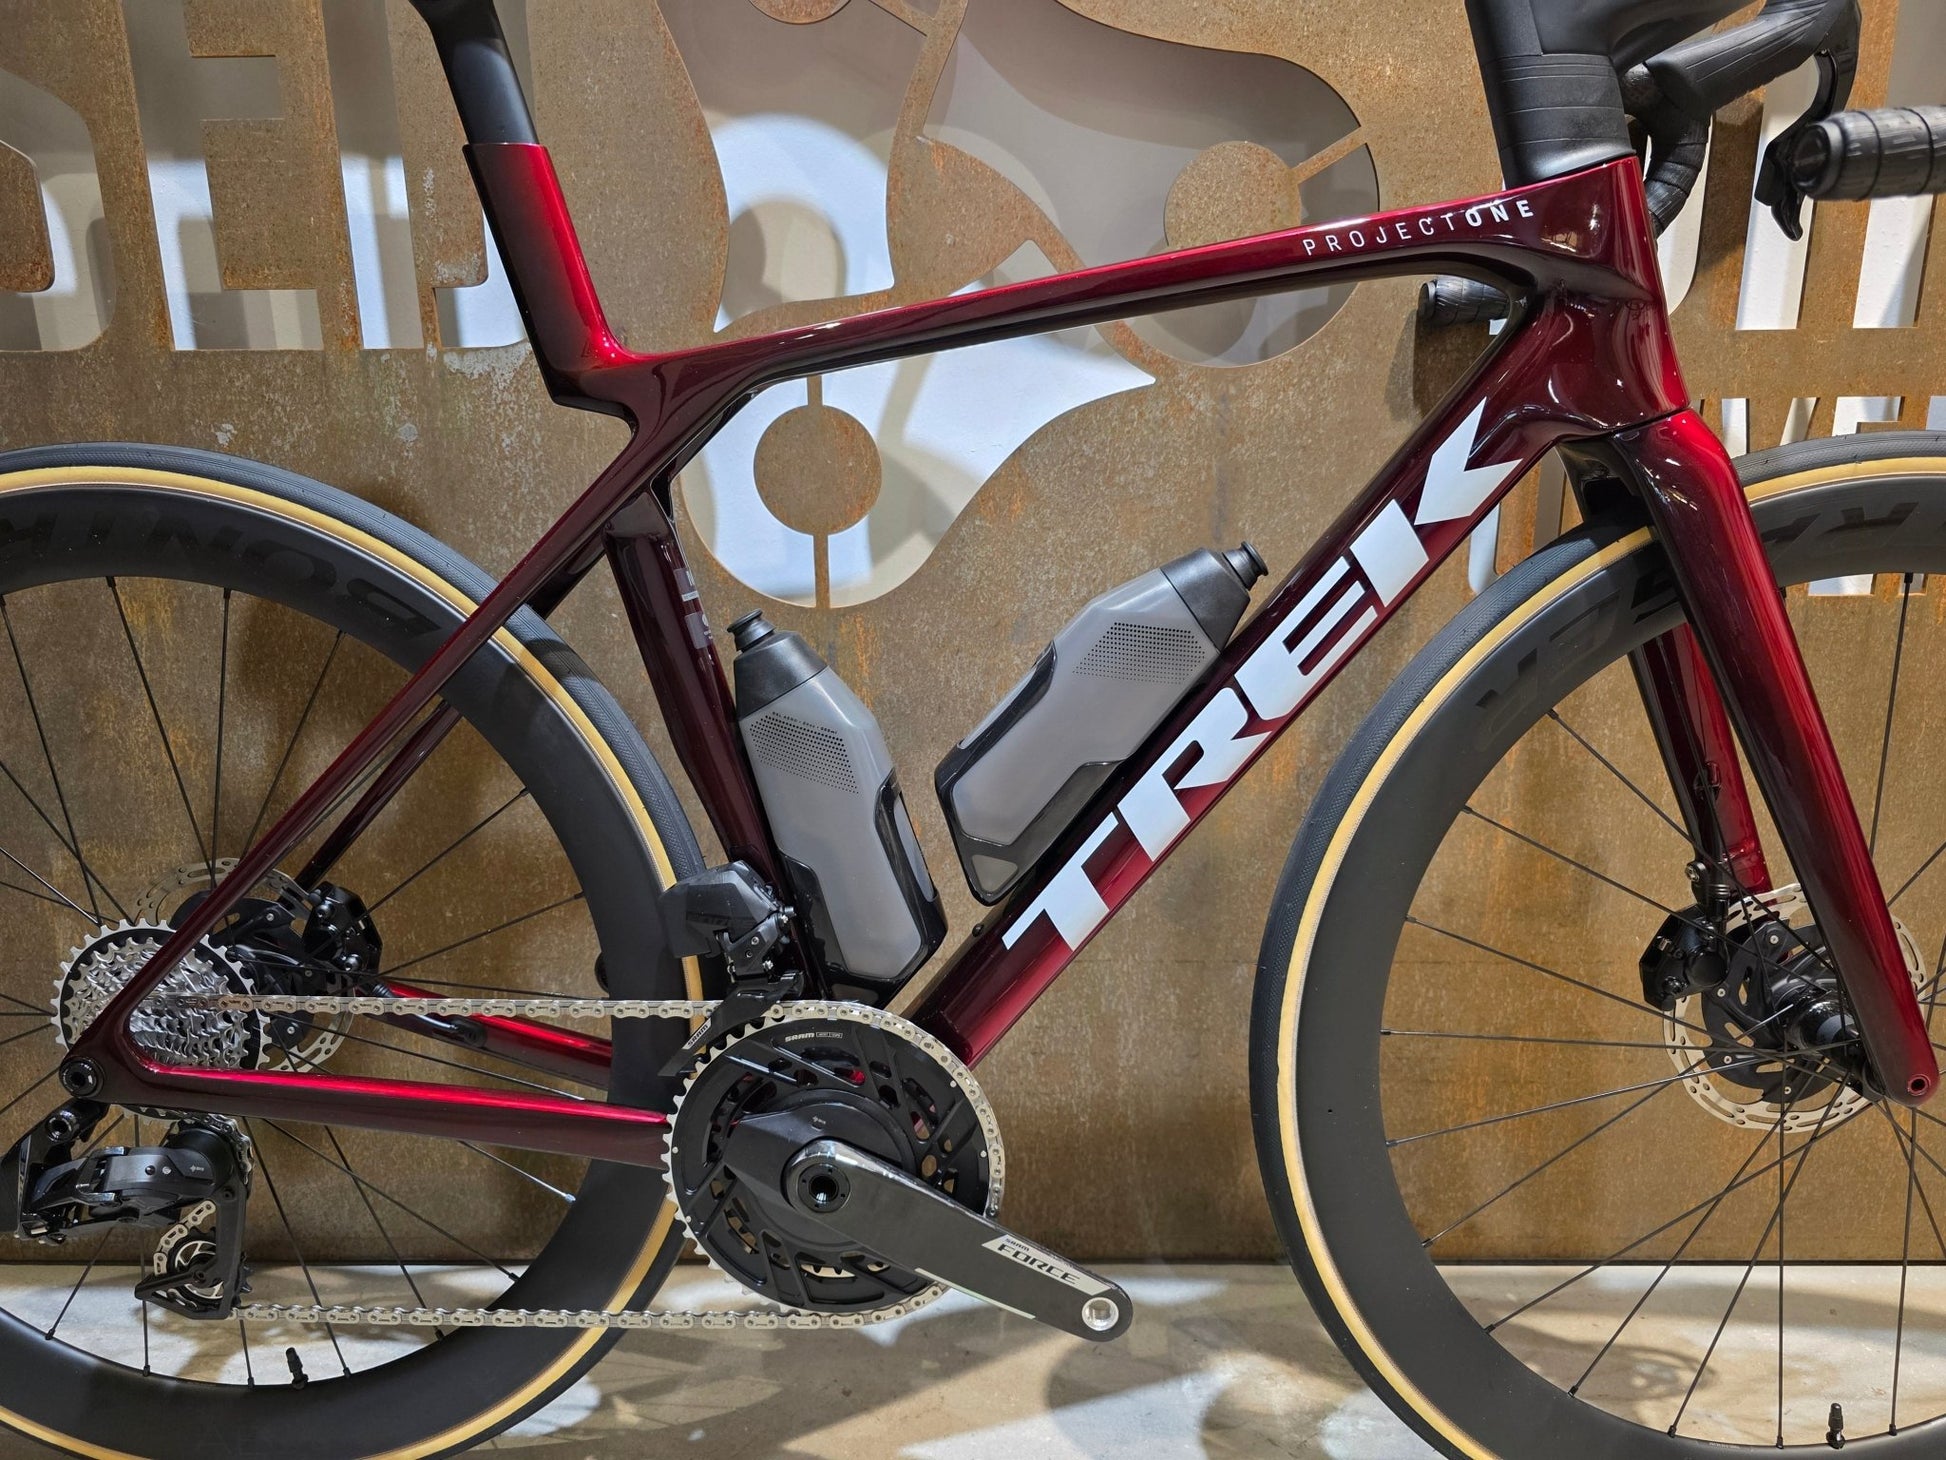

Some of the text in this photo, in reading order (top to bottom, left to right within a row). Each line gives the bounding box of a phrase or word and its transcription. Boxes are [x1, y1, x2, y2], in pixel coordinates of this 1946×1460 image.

[1002, 396, 1523, 952] TREK
[687, 1024, 709, 1046] SRAM
[784, 1032, 815, 1043] SRAM
[997, 1243, 1080, 1285] FORCE
